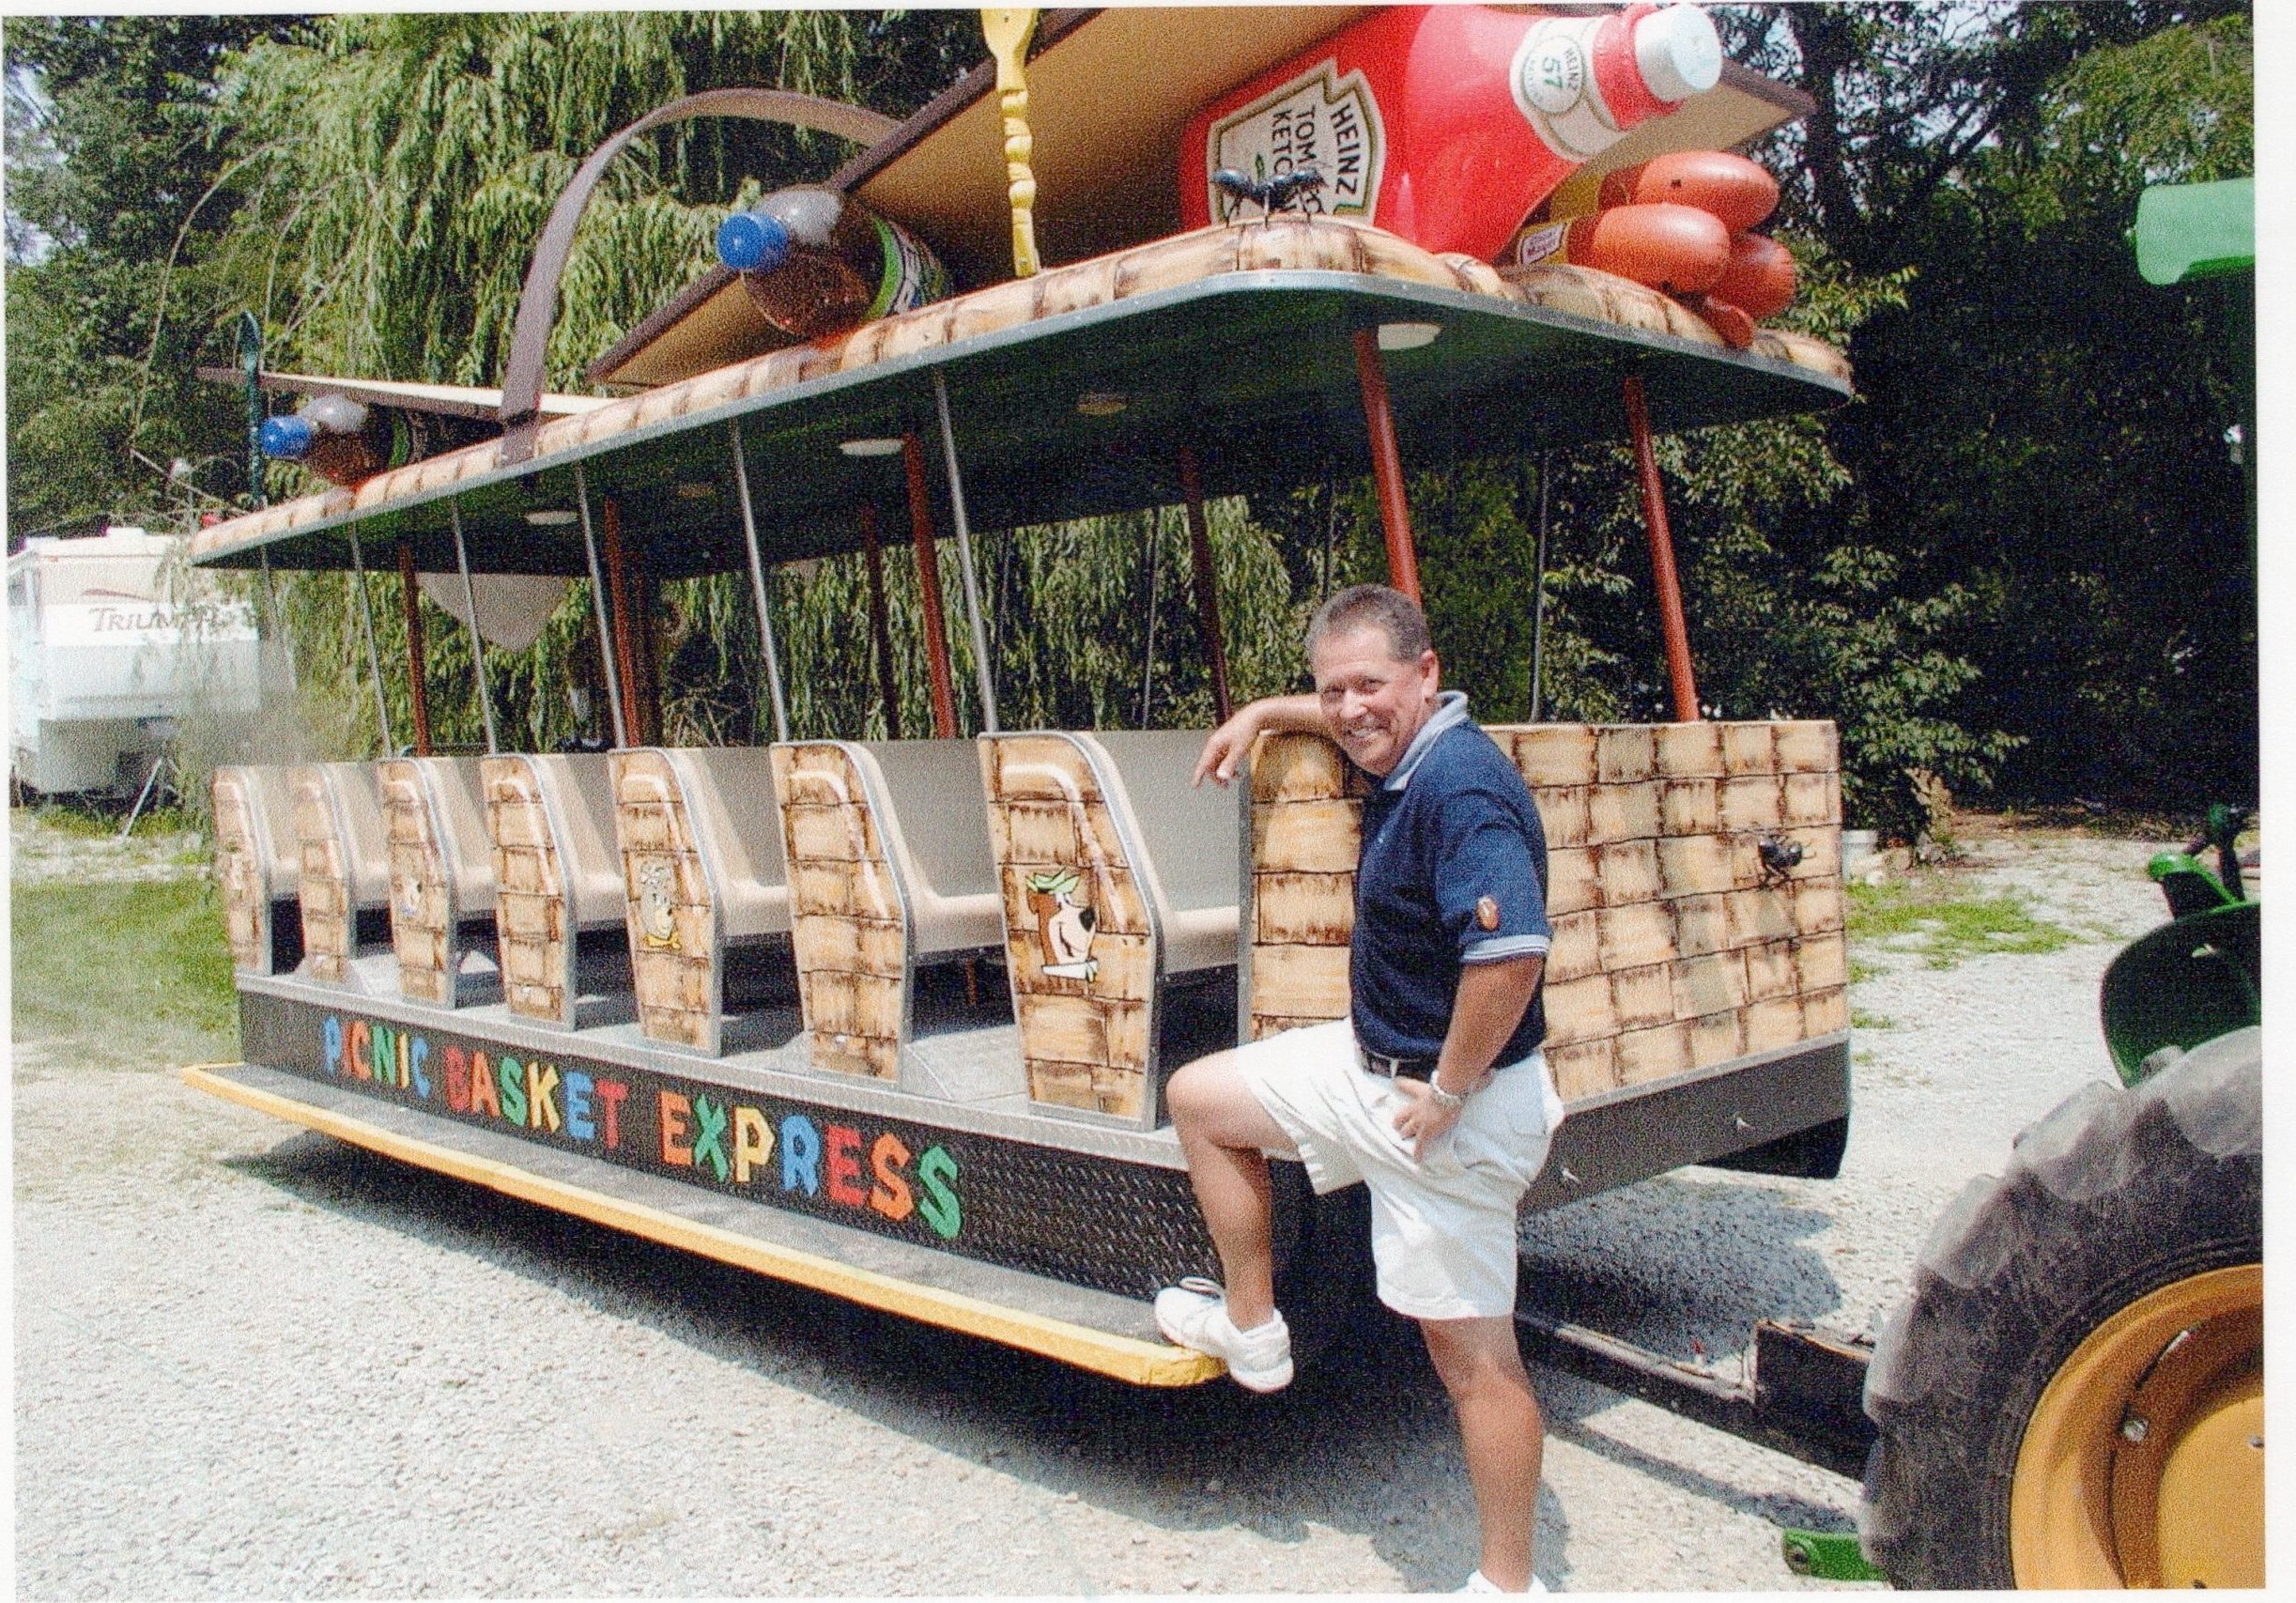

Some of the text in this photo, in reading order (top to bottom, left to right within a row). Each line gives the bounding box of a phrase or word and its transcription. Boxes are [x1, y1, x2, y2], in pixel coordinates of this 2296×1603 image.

[1543, 57, 1564, 88] 57
[1564, 48, 1579, 91] HEINZ
[1295, 103, 1327, 215] TOMO
[1330, 102, 1360, 195] HEINZ
[89, 607, 223, 632] TRIUM
[323, 1014, 963, 1240] PICNIC BASKET EXPRESS
